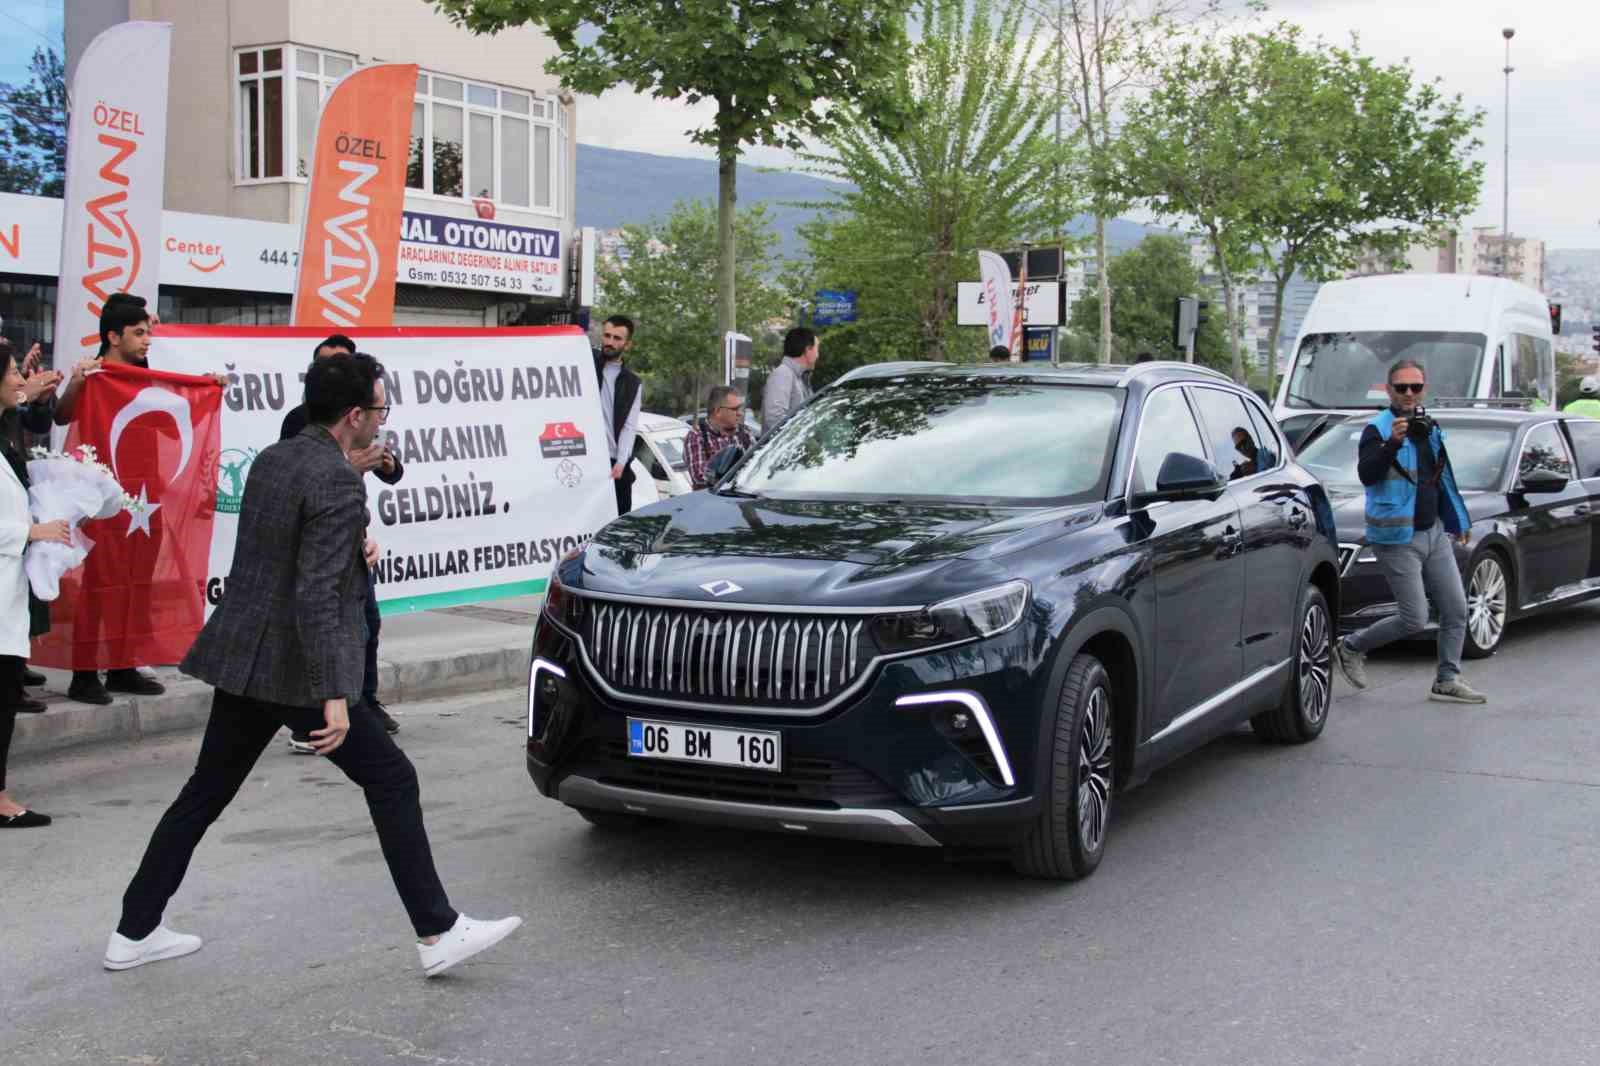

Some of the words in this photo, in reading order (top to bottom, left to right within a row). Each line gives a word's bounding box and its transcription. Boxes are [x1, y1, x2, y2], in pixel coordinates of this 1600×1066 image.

[93, 100, 144, 136] ÖZEL
[335, 131, 387, 160] ÖZEL
[166, 237, 222, 256] Center
[260, 248, 288, 266] 444
[408, 267, 437, 282] Gsm:
[441, 270, 467, 285] 0532
[471, 274, 491, 287] 507
[494, 276, 507, 289] 54
[510, 277, 523, 290] 33
[414, 359, 505, 405] DOĞRU
[511, 365, 582, 401] ADAM
[386, 424, 508, 464] BAKANIM
[474, 533, 592, 572] FEDERASYO
[644, 725, 669, 753] 06
[685, 729, 712, 758] BM
[737, 735, 775, 765] 160
